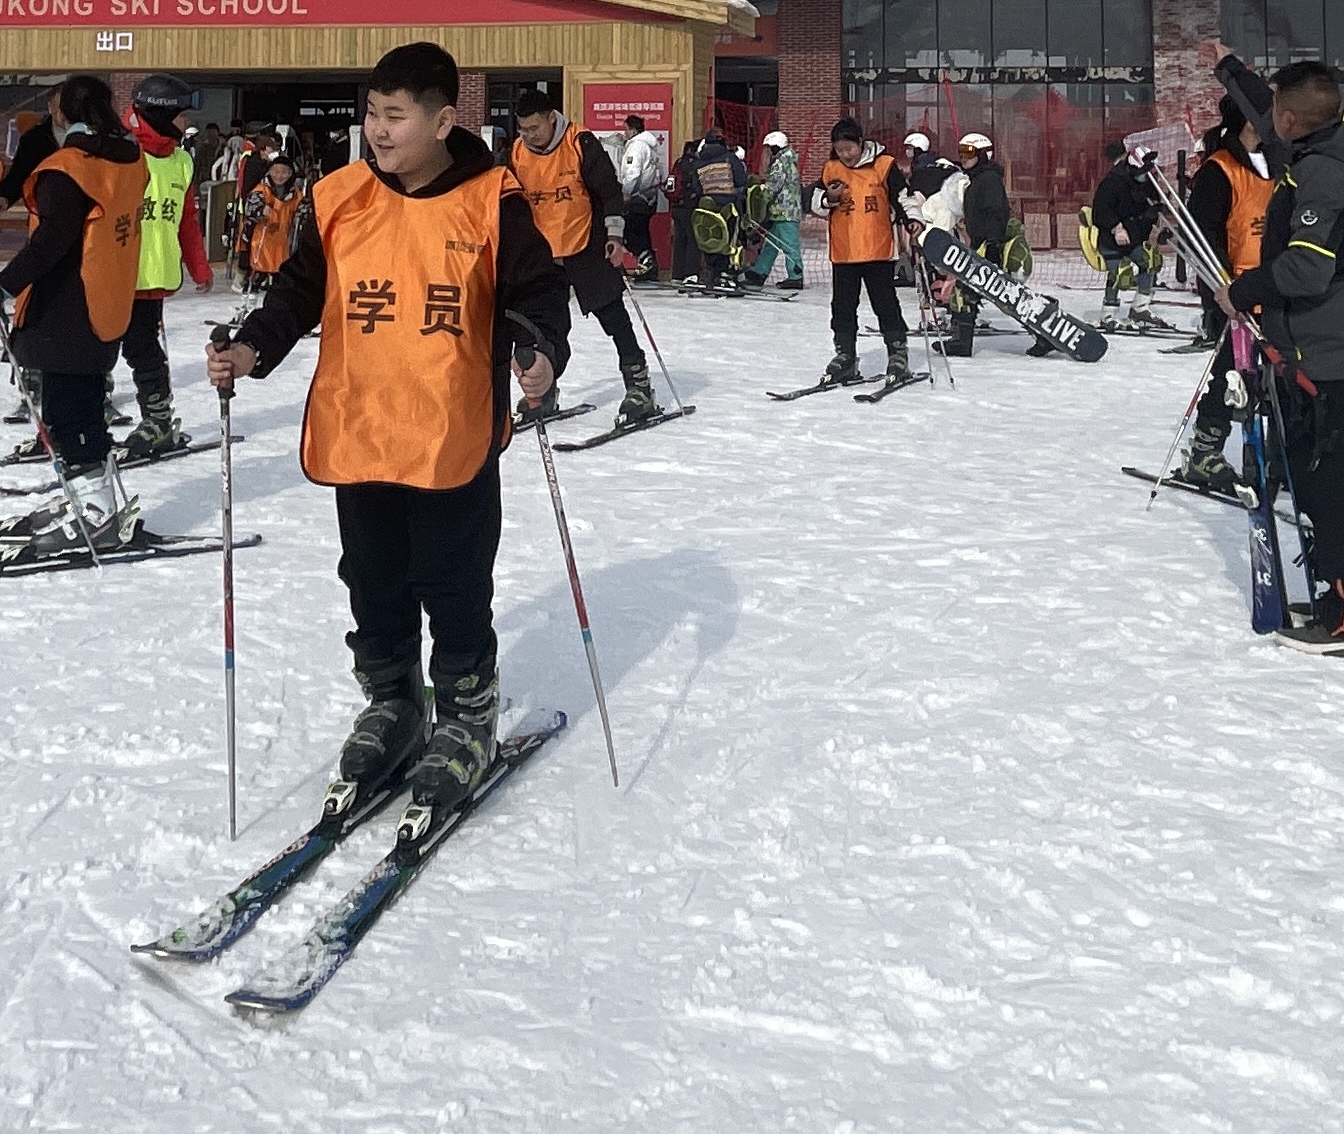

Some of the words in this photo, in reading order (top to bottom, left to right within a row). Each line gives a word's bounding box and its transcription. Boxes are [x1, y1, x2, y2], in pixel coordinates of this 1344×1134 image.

[96, 31, 133, 52] 出口
[346, 278, 464, 338] 学员
[1041, 312, 1086, 352] LIVE
